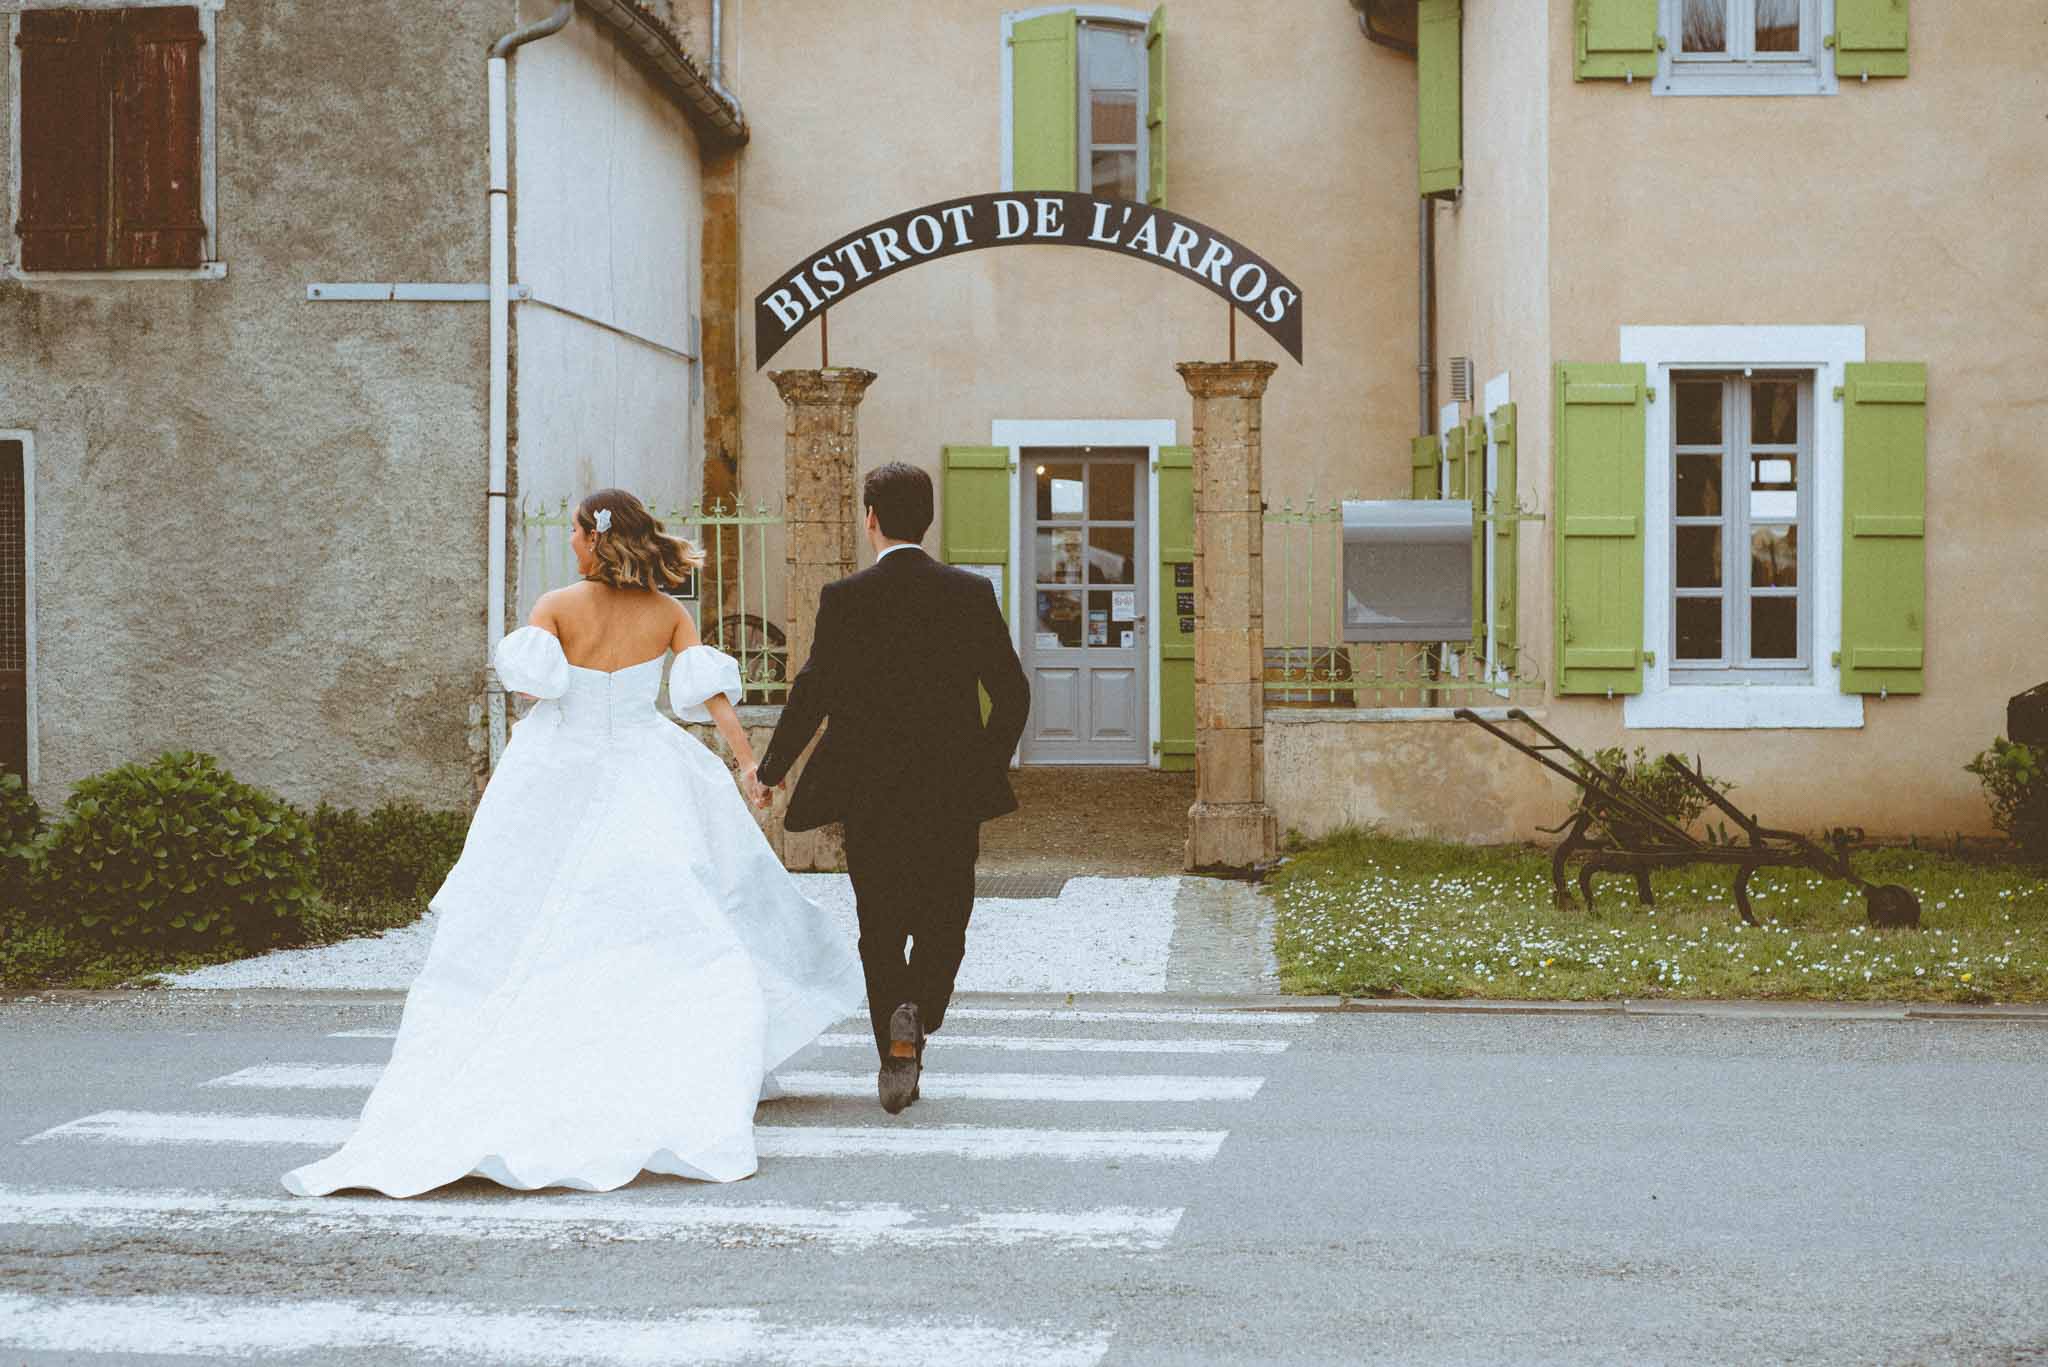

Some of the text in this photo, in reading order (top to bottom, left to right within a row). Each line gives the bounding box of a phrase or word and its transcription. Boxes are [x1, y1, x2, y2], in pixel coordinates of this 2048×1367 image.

[762, 198, 1297, 331] BISTROT DE L'ARROS
